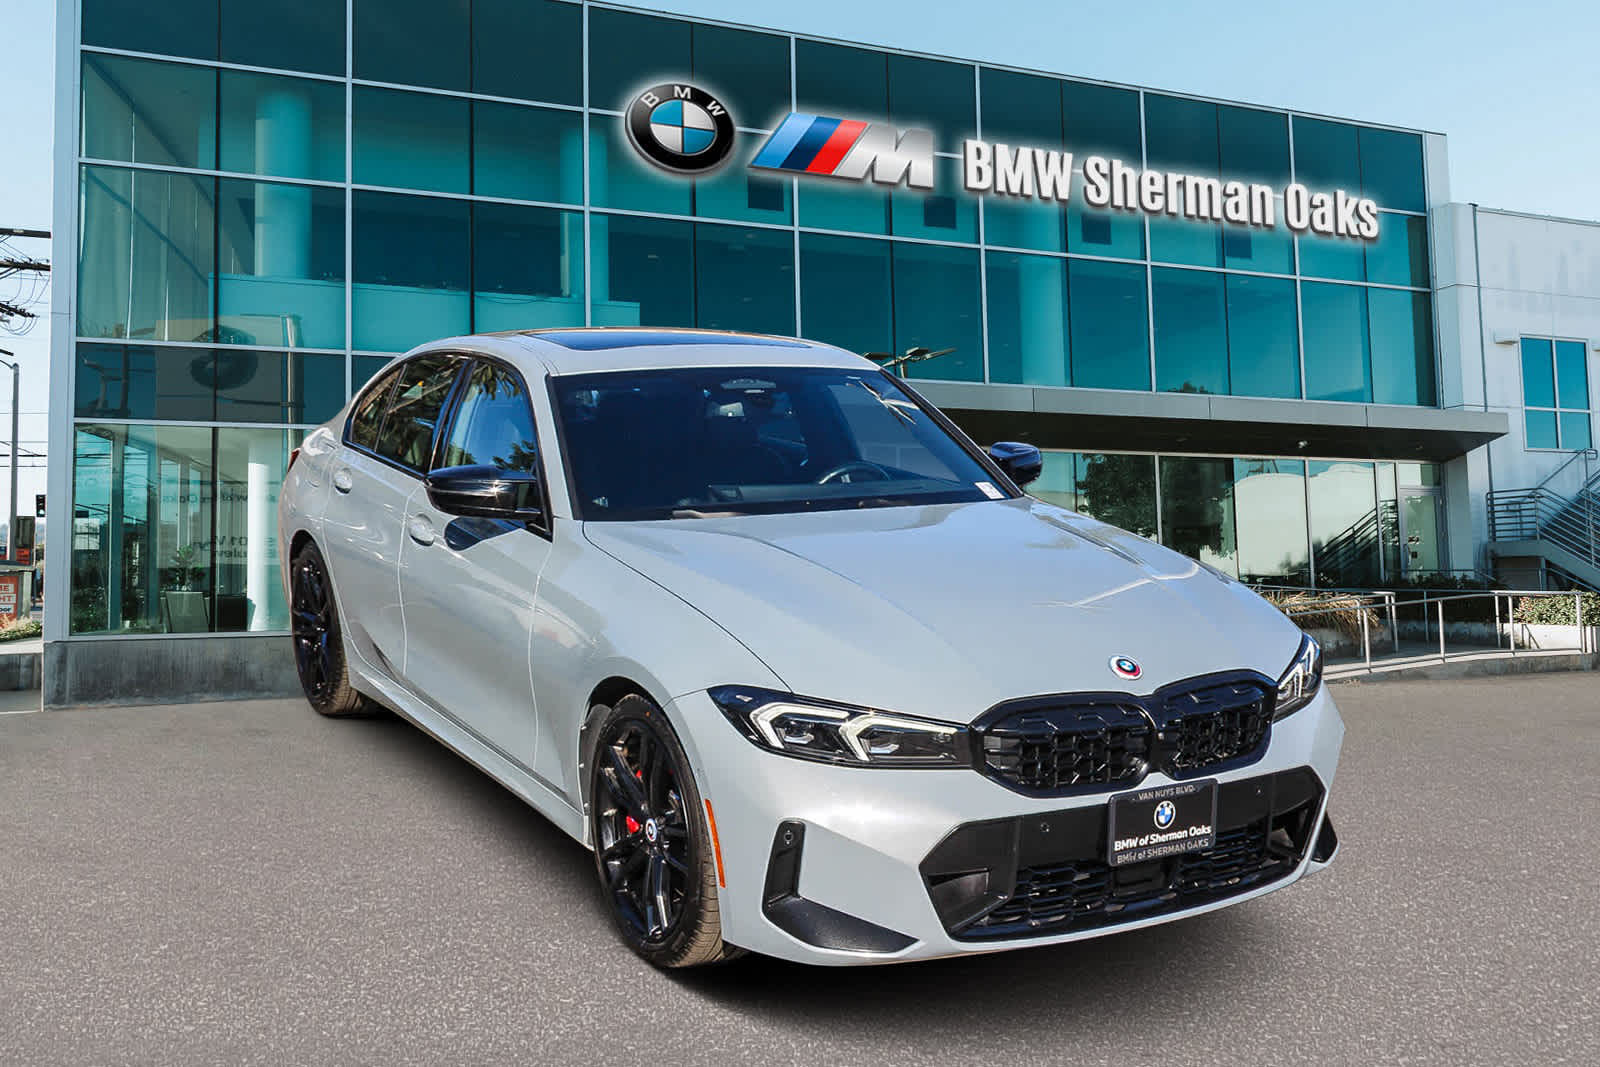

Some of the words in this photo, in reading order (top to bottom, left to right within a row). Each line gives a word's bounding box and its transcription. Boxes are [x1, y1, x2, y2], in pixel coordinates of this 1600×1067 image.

[640, 85, 726, 117] BMW
[964, 139, 1073, 201] BMW
[1084, 155, 1275, 227] Sherman
[1285, 183, 1380, 240] Oaks
[1138, 791, 1155, 801] VAN
[1155, 788, 1176, 798] NUYS
[1114, 838, 1139, 851] BMW
[1139, 834, 1148, 846] of
[1150, 830, 1188, 843] Sherman
[1189, 824, 1212, 837] Oaks
[1117, 852, 1137, 864] BMW
[1138, 850, 1147, 860] of
[1147, 843, 1186, 858] SHERMAN
[1187, 838, 1209, 849] OAKS
